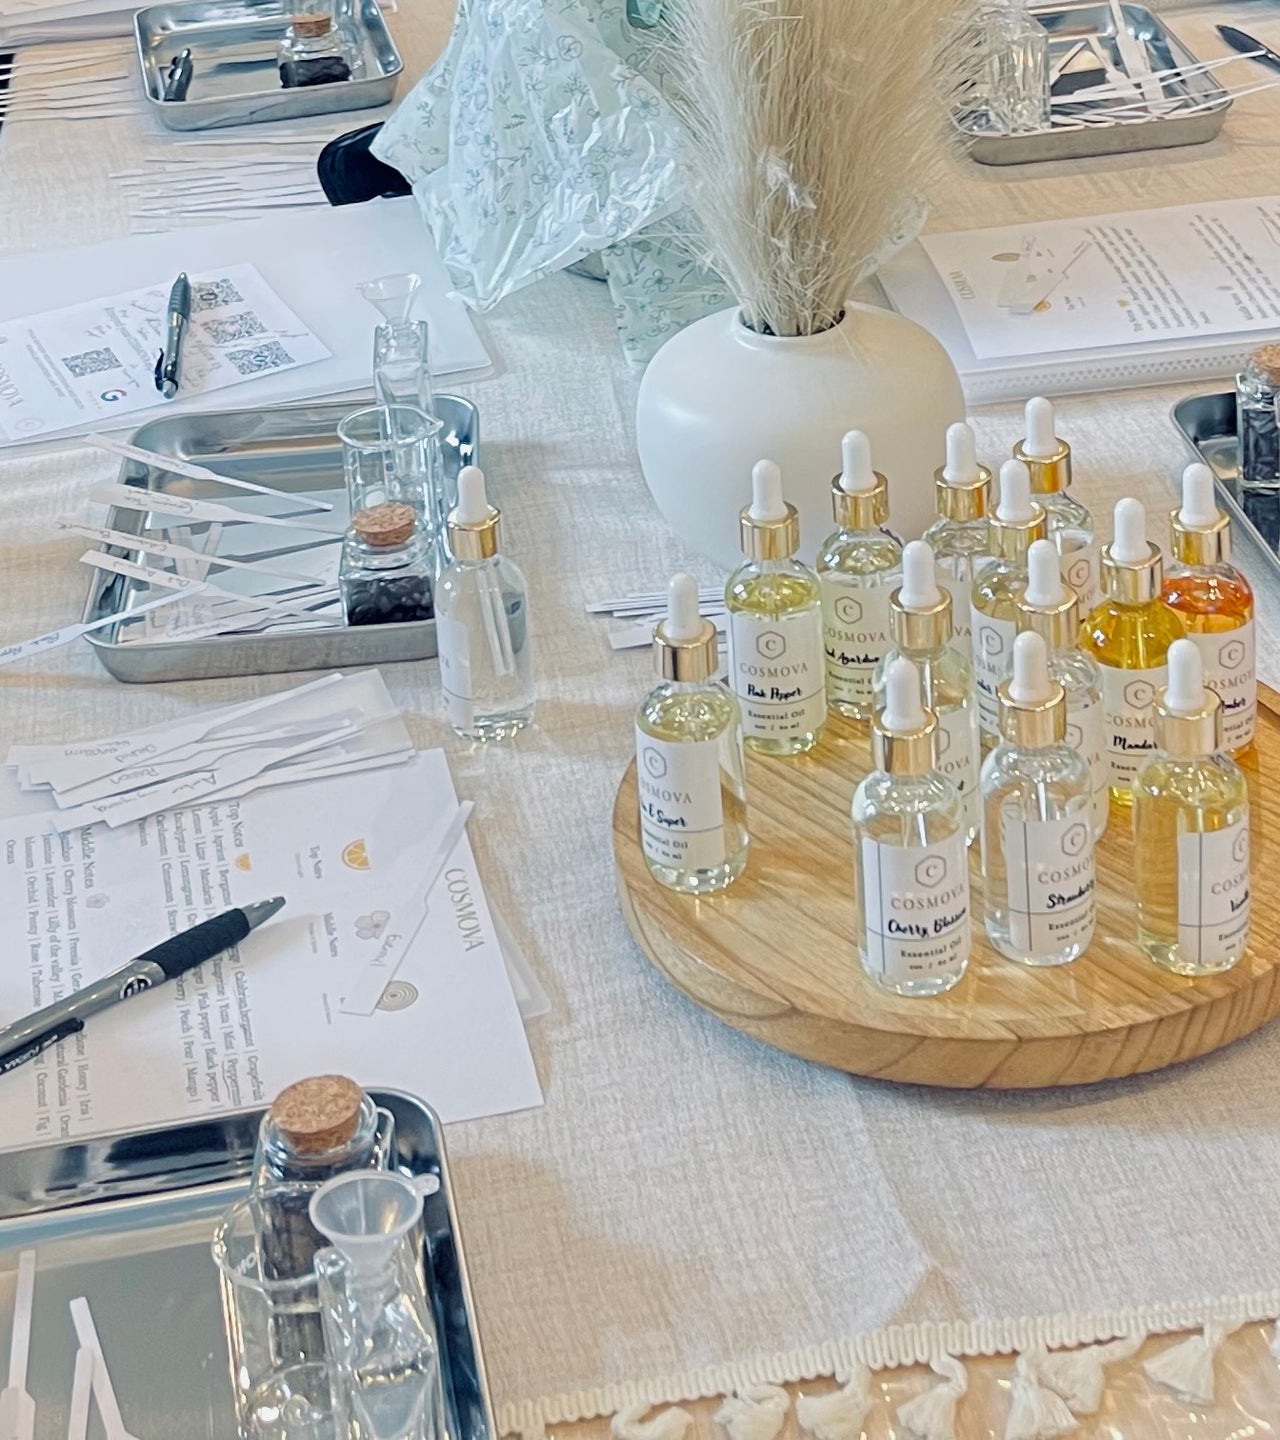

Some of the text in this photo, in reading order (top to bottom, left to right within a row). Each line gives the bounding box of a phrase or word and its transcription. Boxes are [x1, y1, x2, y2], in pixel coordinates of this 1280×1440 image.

[739, 662, 809, 679] COSMOVA
[748, 709, 806, 720] Essential Oil
[225, 800, 243, 847] Top Notes
[79, 824, 95, 888] Middle Notes
[443, 867, 485, 953] COSMOVA
[900, 946, 948, 958] Essential
